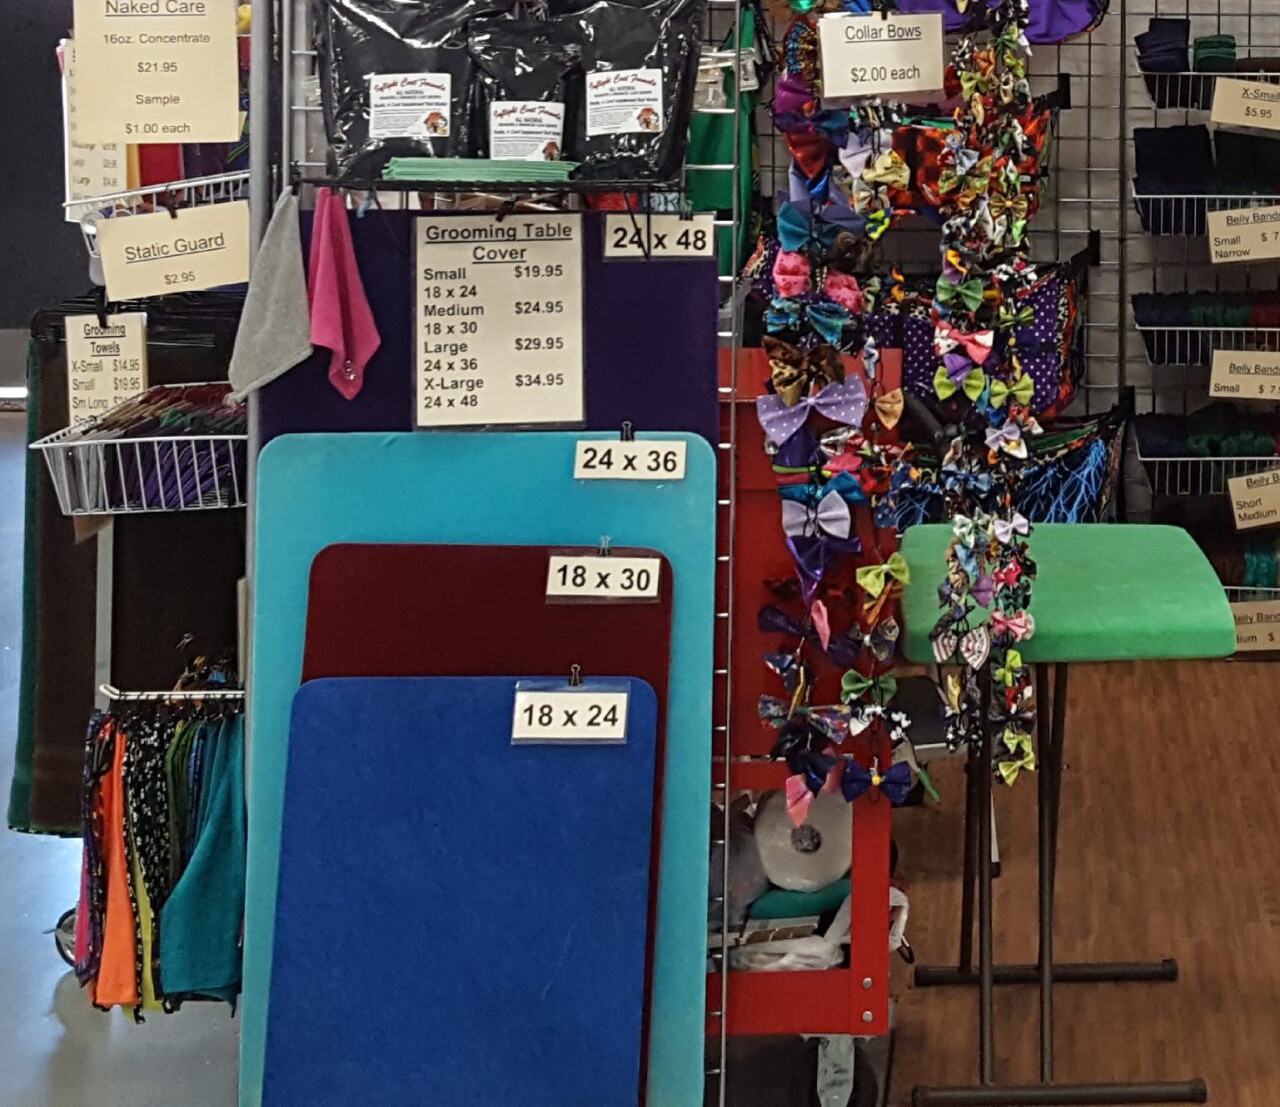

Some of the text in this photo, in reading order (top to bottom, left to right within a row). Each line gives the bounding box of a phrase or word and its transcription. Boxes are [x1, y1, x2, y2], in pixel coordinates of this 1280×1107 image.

[103, 32, 211, 45] 16oz. Concentrate
[844, 23, 922, 40] Collar Bows
[137, 61, 178, 74] $21.95
[850, 65, 921, 83] $2.00 each
[135, 93, 180, 107] Sample
[1241, 87, 1280, 102] X-Small
[1244, 106, 1273, 119] $5.95
[124, 122, 191, 135] $1.00 each
[1226, 214, 1250, 227] Belly
[425, 222, 573, 242] Grooming Table
[612, 226, 707, 251] 24 x 48
[124, 232, 225, 262] Static Guard
[1213, 235, 1241, 247] Small
[472, 245, 527, 261] Cover
[1215, 248, 1250, 260] Narrow
[163, 271, 196, 286] $2.95
[423, 264, 564, 281] Small $19.95
[424, 285, 478, 299] 18 x 24
[423, 300, 564, 317] Medium $24.95
[424, 321, 478, 335] 18 x 30
[90, 340, 121, 354] Towels
[423, 337, 564, 356] Large $29.95
[71, 358, 141, 373] X-Small $14.95
[423, 358, 478, 372] 24 x 36
[1229, 363, 1252, 375] Belly
[72, 377, 141, 391] Small $19.95
[423, 373, 564, 392] X-Large $34.95
[1213, 383, 1240, 394] Small
[72, 396, 86, 409] Sm
[88, 396, 108, 410] Long
[423, 395, 478, 409] 24 x 48
[581, 447, 678, 473] 24 x 36
[1246, 476, 1270, 489] Belly
[1235, 498, 1263, 510] Short
[1237, 508, 1278, 523] Medium
[556, 564, 651, 591] 18 x 30
[522, 704, 619, 727] 18 x 24
